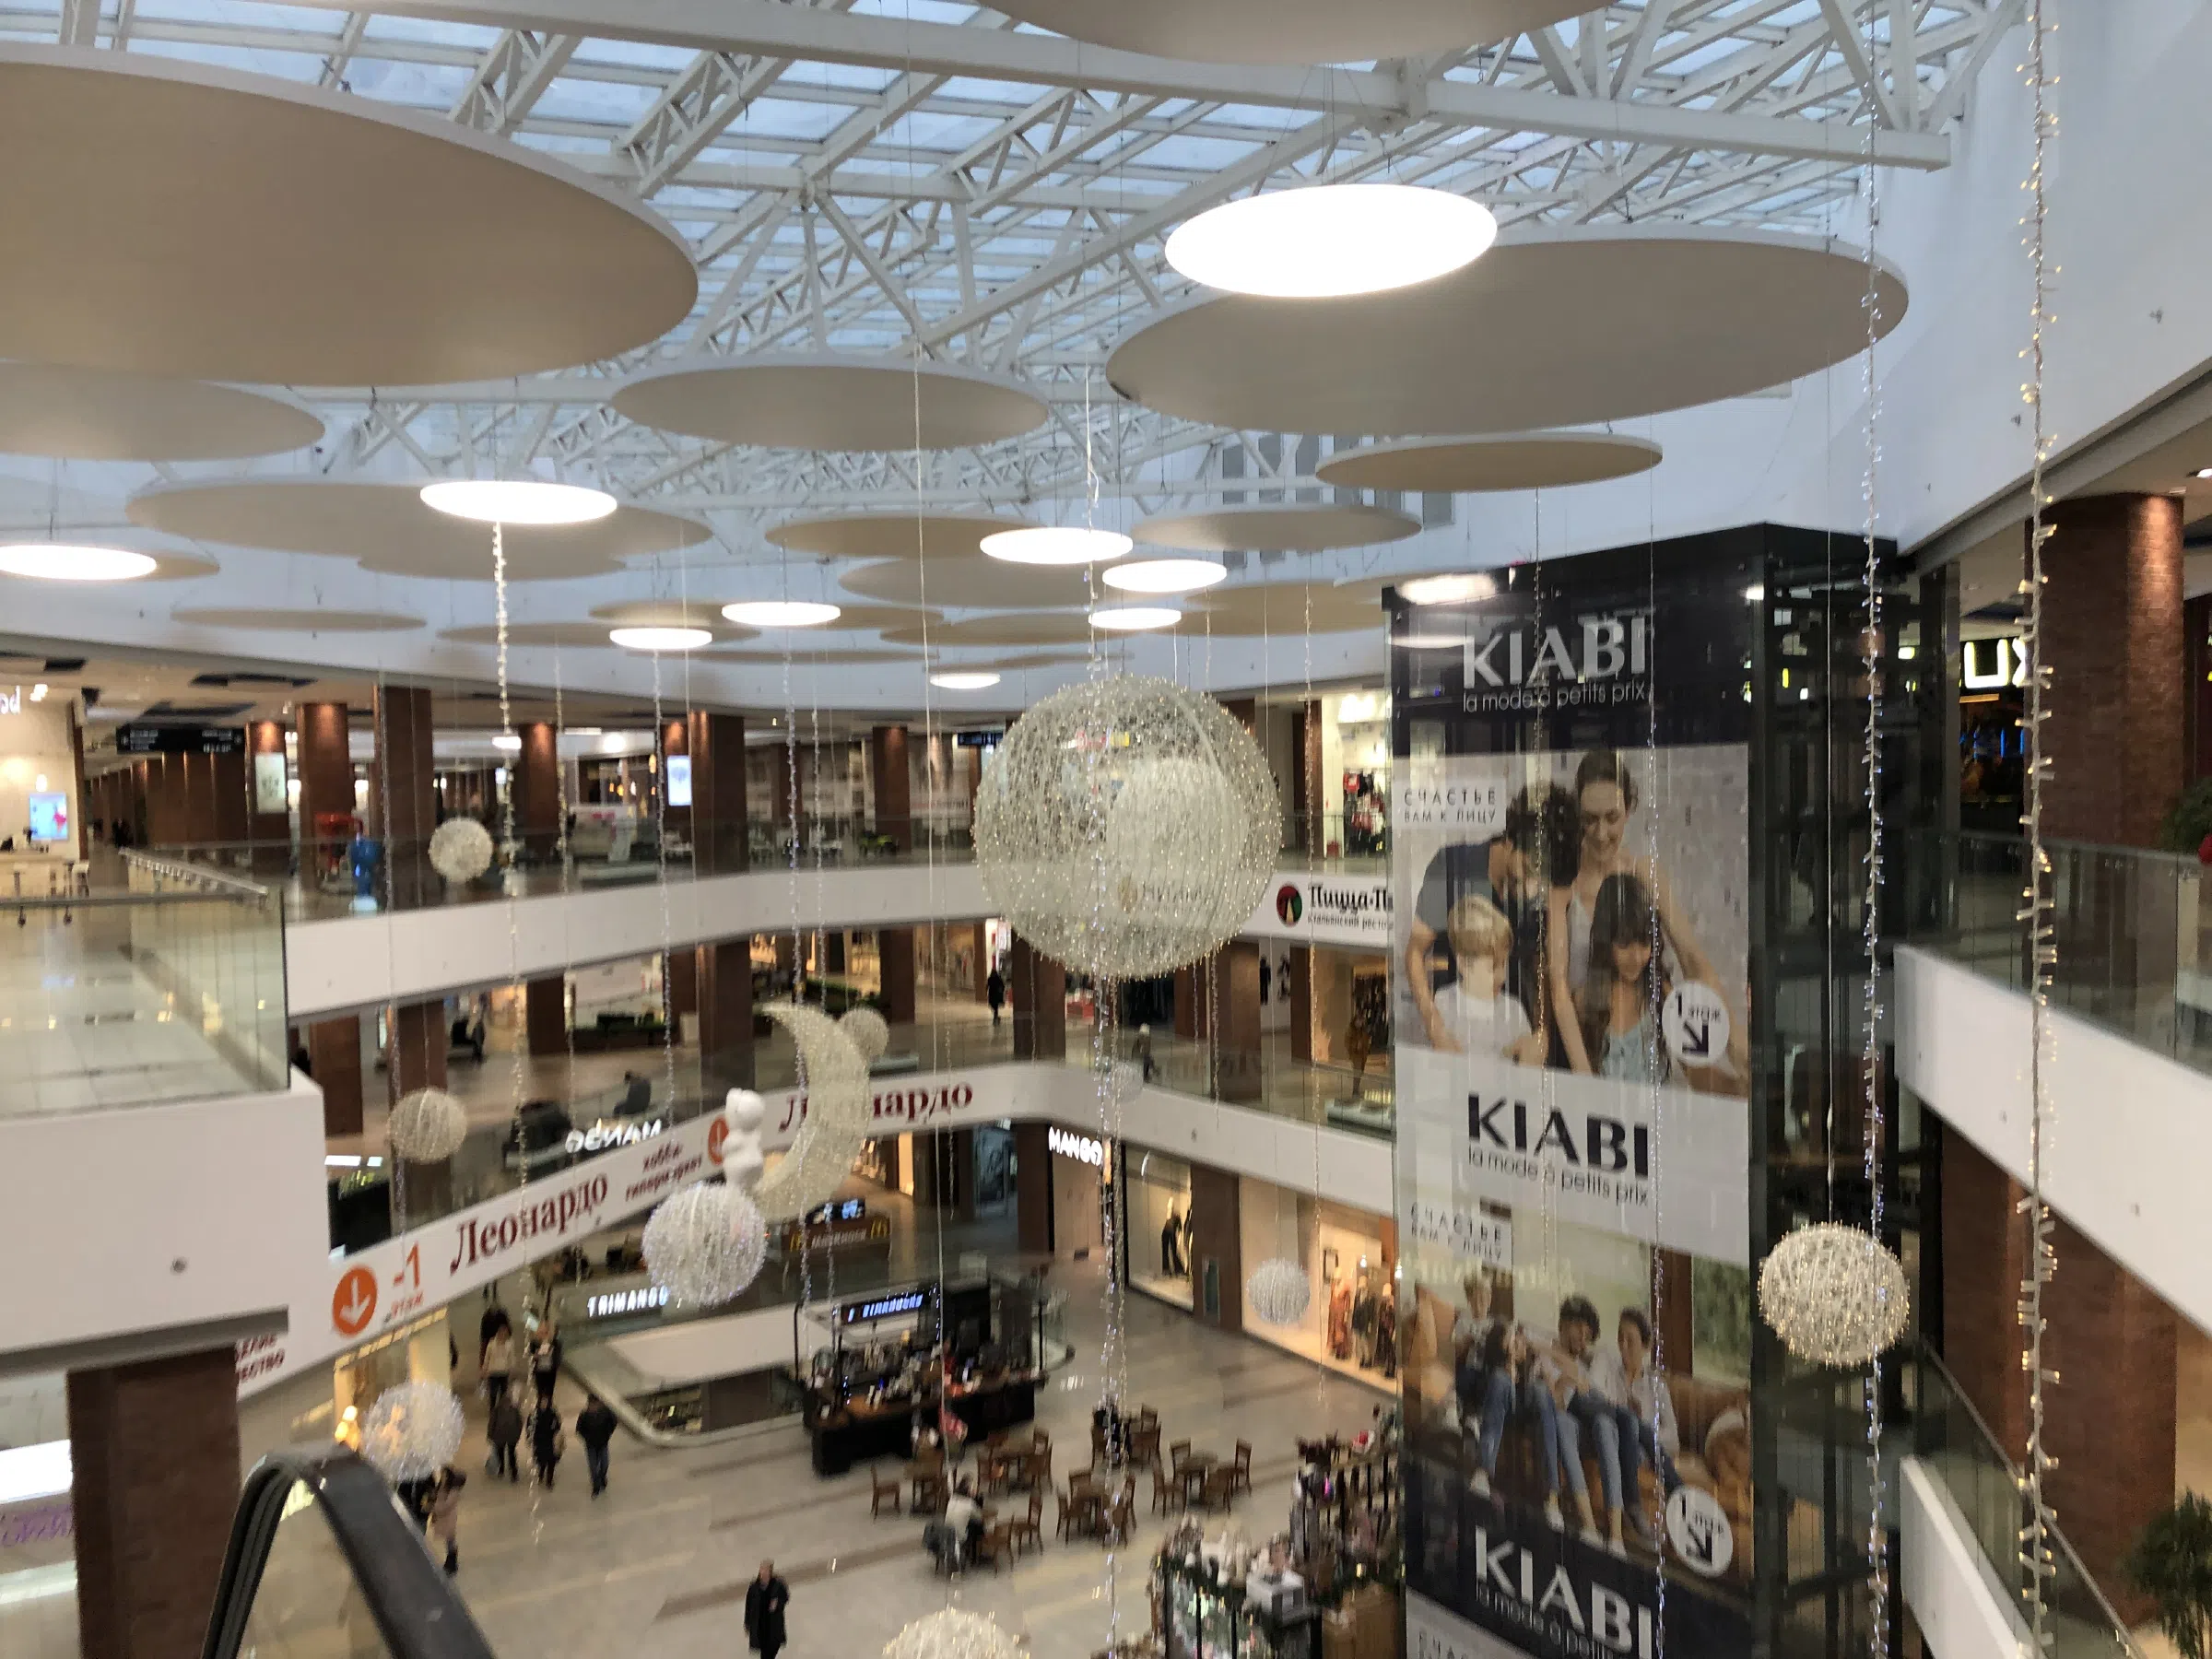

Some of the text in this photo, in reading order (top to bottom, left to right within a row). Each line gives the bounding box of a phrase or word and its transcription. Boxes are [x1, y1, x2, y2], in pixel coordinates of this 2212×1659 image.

[1463, 617, 1645, 689] KIABI
[1464, 689, 1477, 713] la
[1483, 690, 1534, 712] mode
[1558, 678, 1606, 710] petits
[1613, 679, 1645, 707] prix
[1405, 786, 1496, 806] СЧАСТЬЕ
[1405, 808, 1432, 823] ВАМ
[1456, 807, 1496, 826] ЛИЦУ
[1309, 882, 1393, 914] Пицца-П
[1676, 990, 1682, 1018] 1
[1048, 1125, 1102, 1167] MANGO
[1468, 1090, 1649, 1182] KIABI
[1468, 1145, 1483, 1168] la
[1488, 1151, 1538, 1181] mode
[1562, 1168, 1610, 1199] petits
[1617, 1181, 1648, 1206] prix
[450, 1172, 608, 1276] Леонардо
[1476, 1524, 1653, 1659] KIABI
